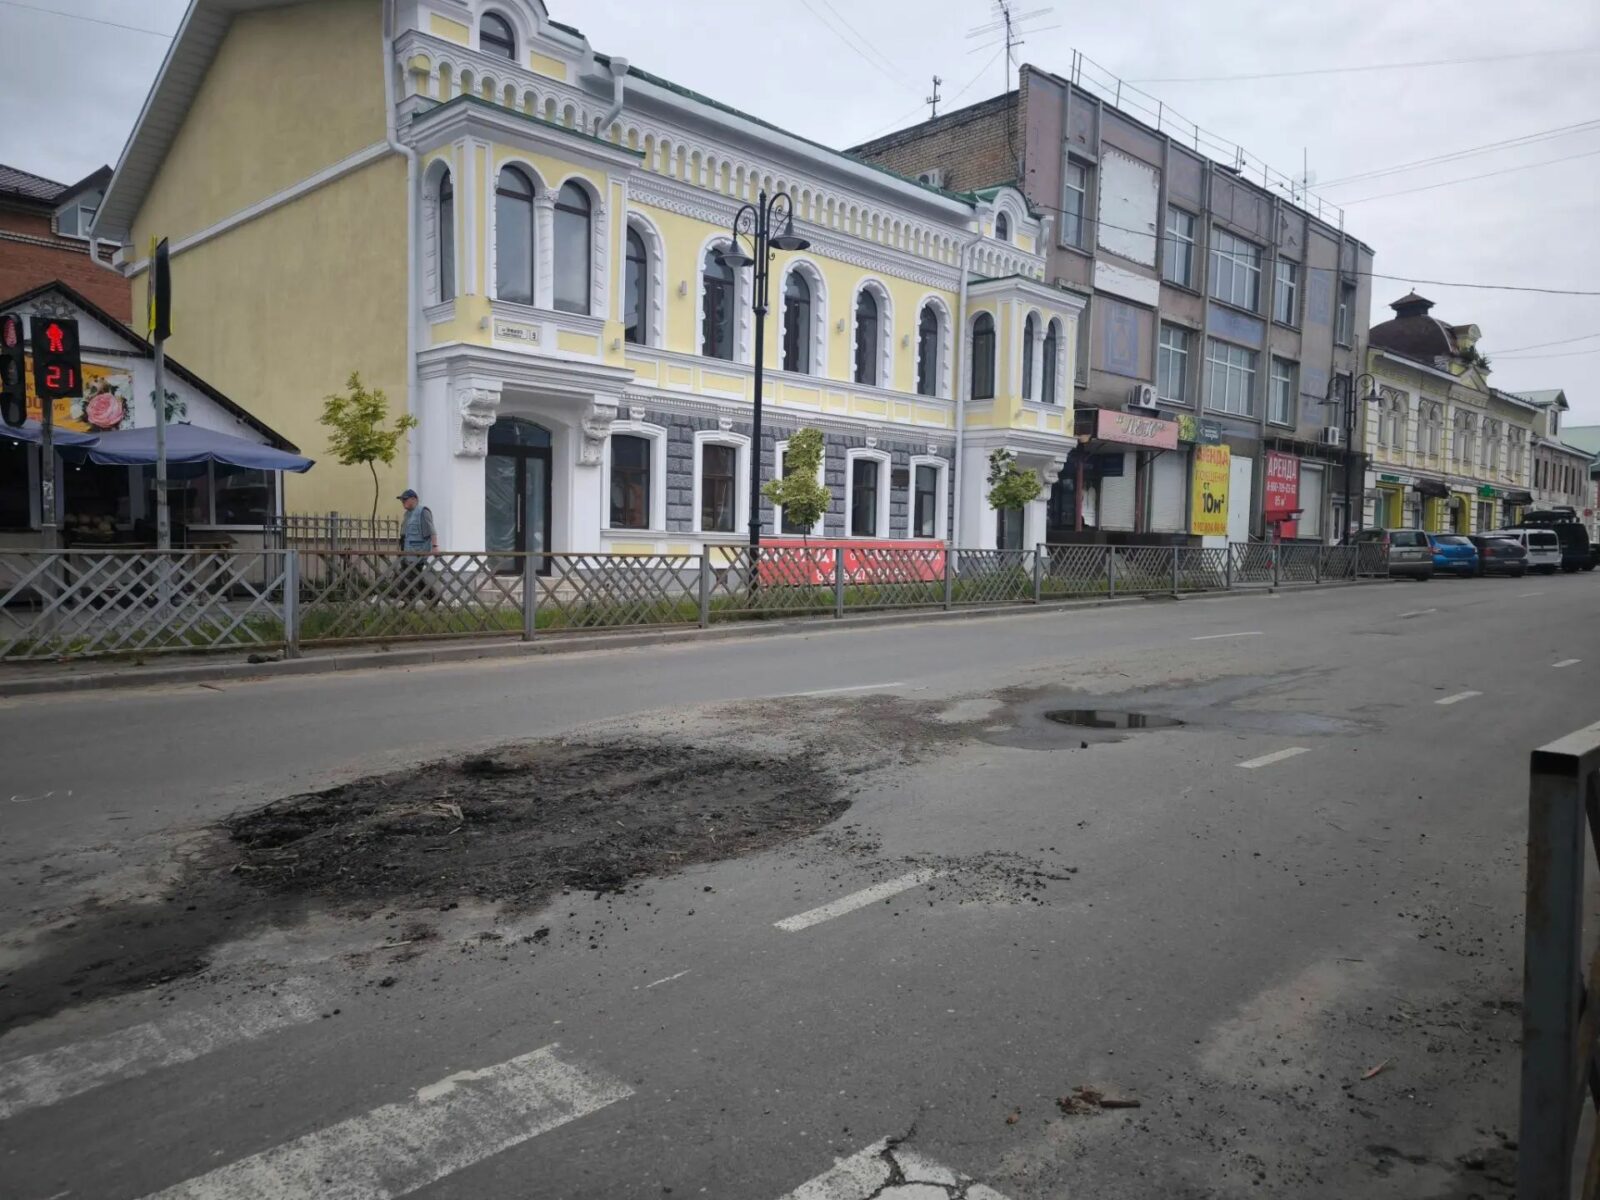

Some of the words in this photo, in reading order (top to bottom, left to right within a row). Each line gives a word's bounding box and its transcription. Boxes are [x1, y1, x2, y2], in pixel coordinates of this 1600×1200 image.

[46, 365, 75, 388] 21
[1196, 447, 1228, 466] АРЕНДА
[1267, 456, 1297, 481] АРЕНДА
